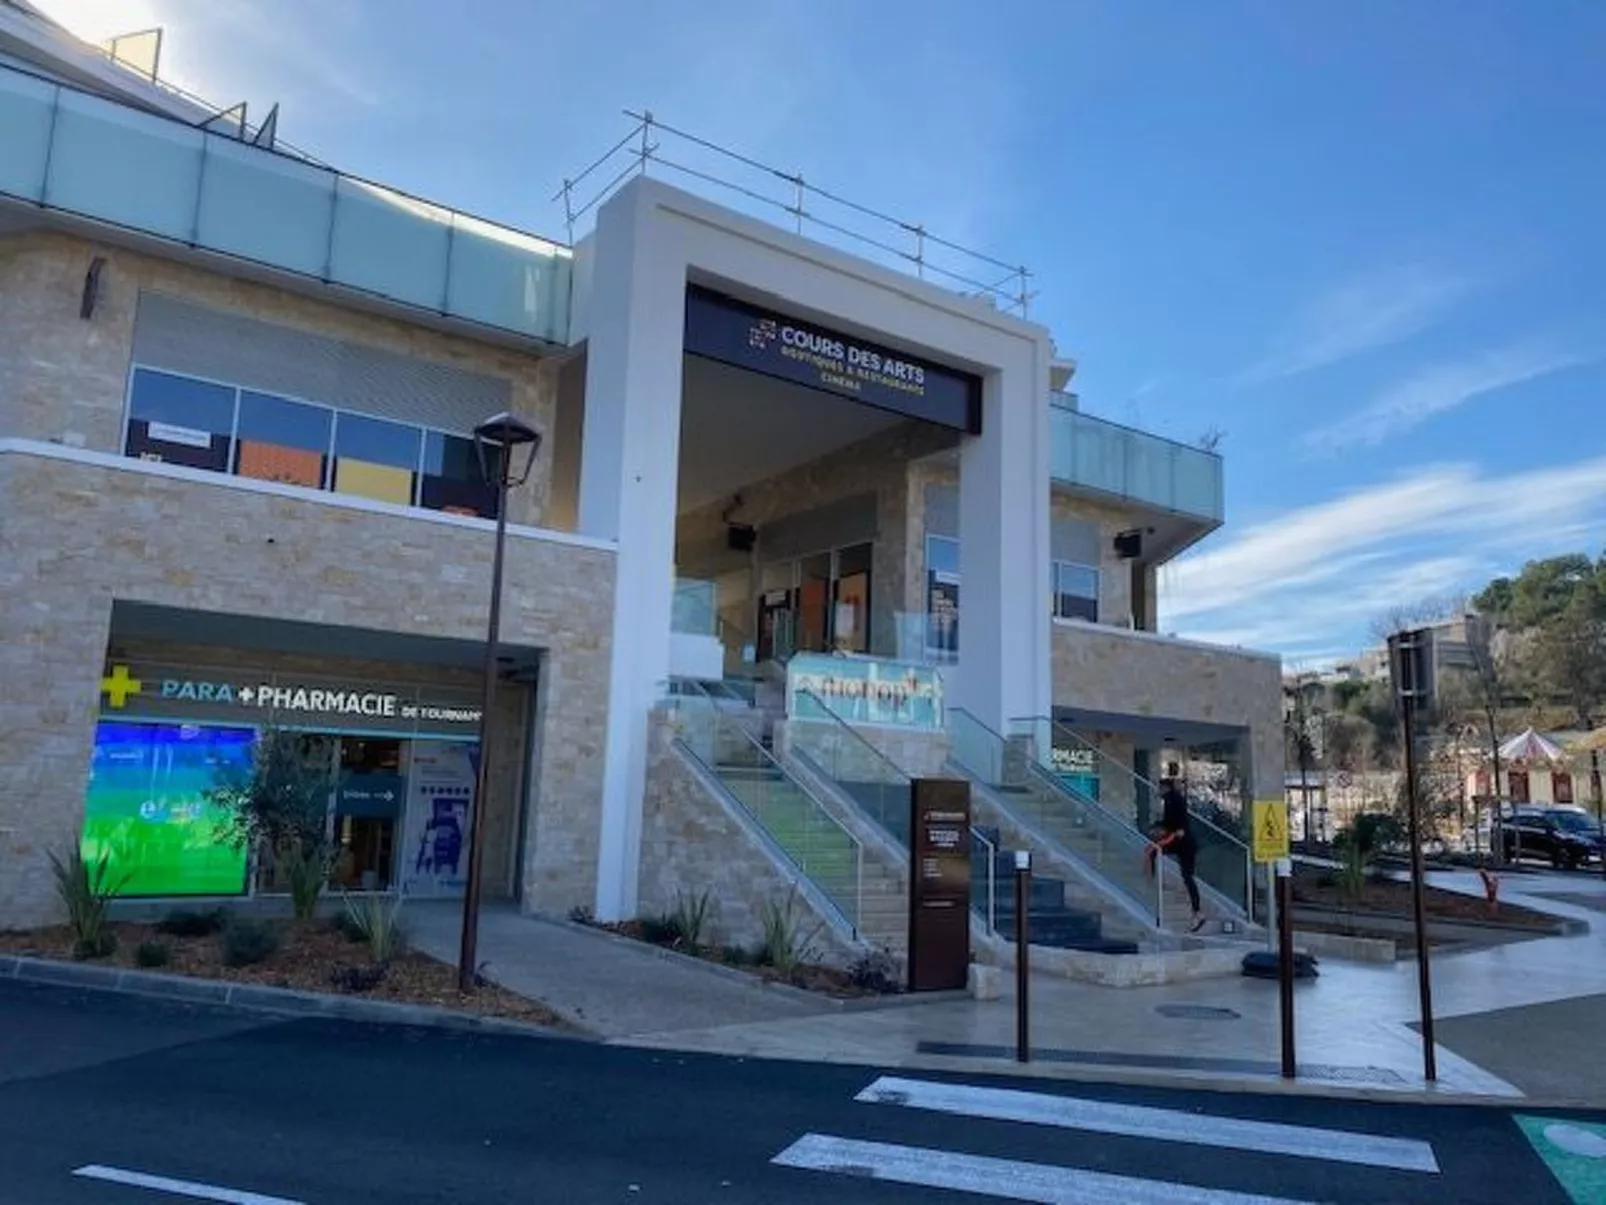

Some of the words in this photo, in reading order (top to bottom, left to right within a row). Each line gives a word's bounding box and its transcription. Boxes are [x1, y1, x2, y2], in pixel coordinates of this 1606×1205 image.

[781, 326, 844, 359] COURS
[849, 346, 881, 370] DES
[883, 358, 924, 384] ARTS
[162, 680, 233, 702] PARA
[258, 685, 397, 717] PHARMACIE
[401, 705, 417, 718] DE
